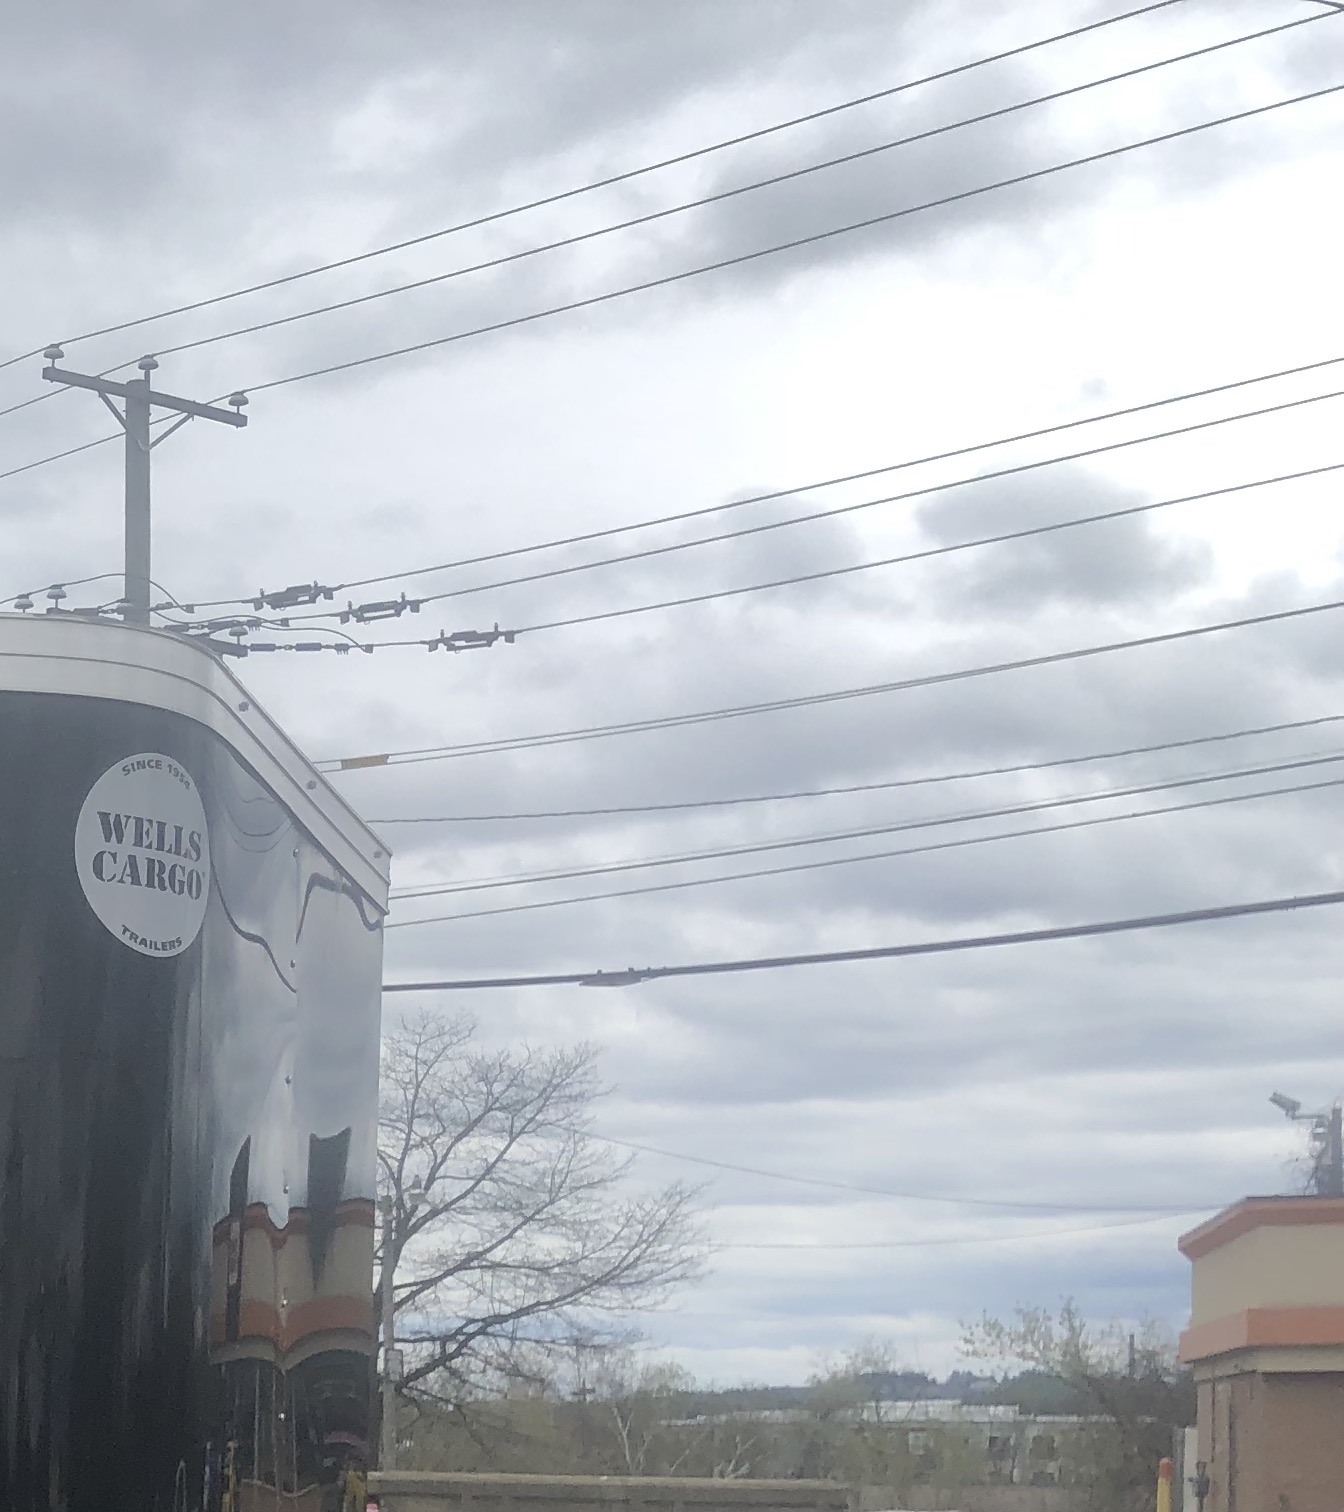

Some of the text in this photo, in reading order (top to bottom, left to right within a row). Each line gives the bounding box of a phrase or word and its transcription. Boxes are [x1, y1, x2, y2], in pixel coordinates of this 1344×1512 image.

[121, 759, 163, 776] SINCE
[96, 811, 202, 862] WELLS
[92, 850, 202, 900] CARGO
[121, 924, 183, 951] TRAILERS
